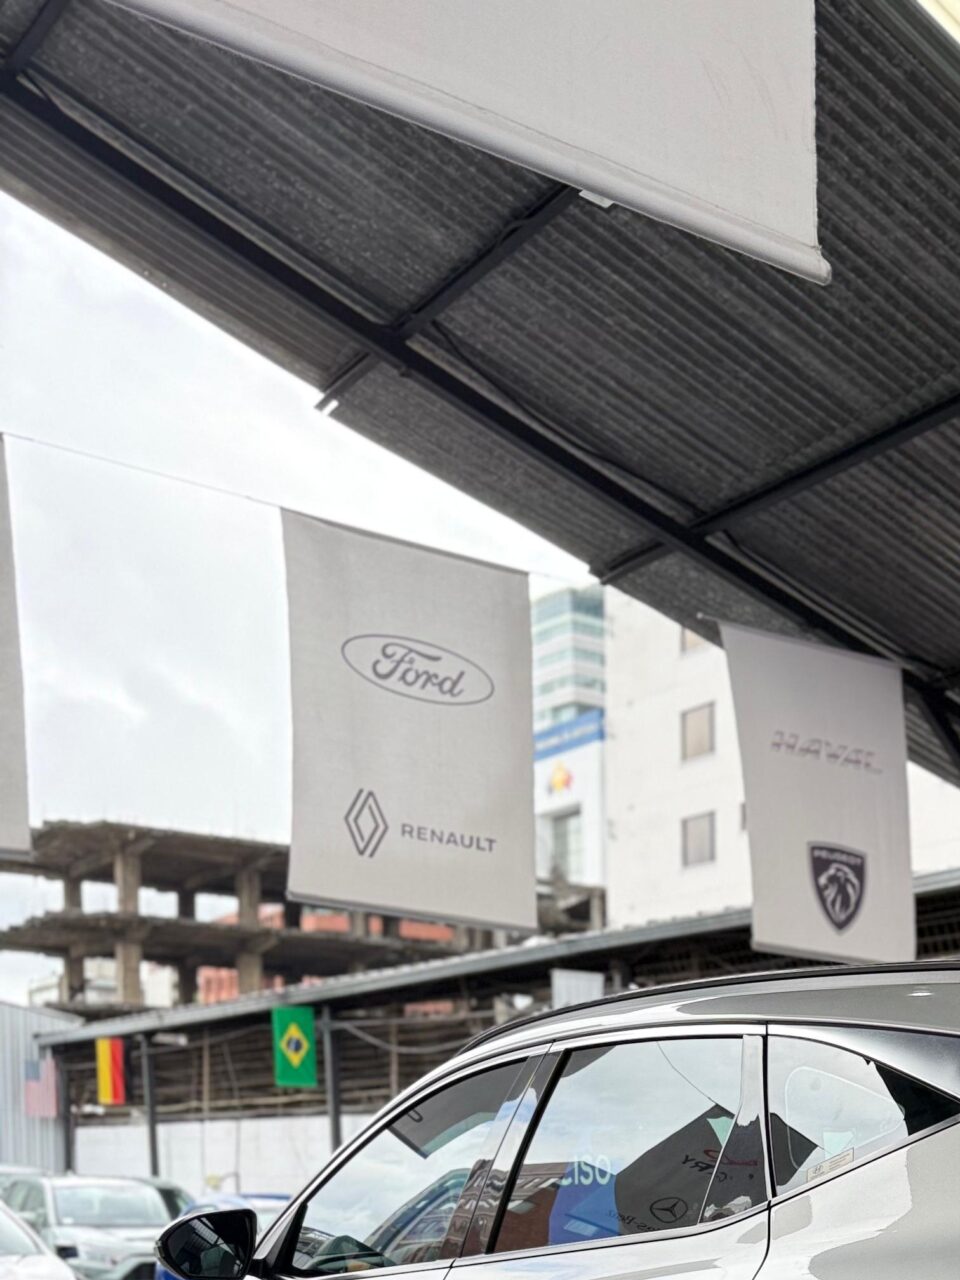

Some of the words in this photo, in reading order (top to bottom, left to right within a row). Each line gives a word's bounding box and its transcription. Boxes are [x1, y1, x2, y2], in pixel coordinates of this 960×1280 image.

[372, 642, 465, 698] Ford
[770, 730, 884, 775] HAVAL
[400, 822, 498, 853] RENAULT
